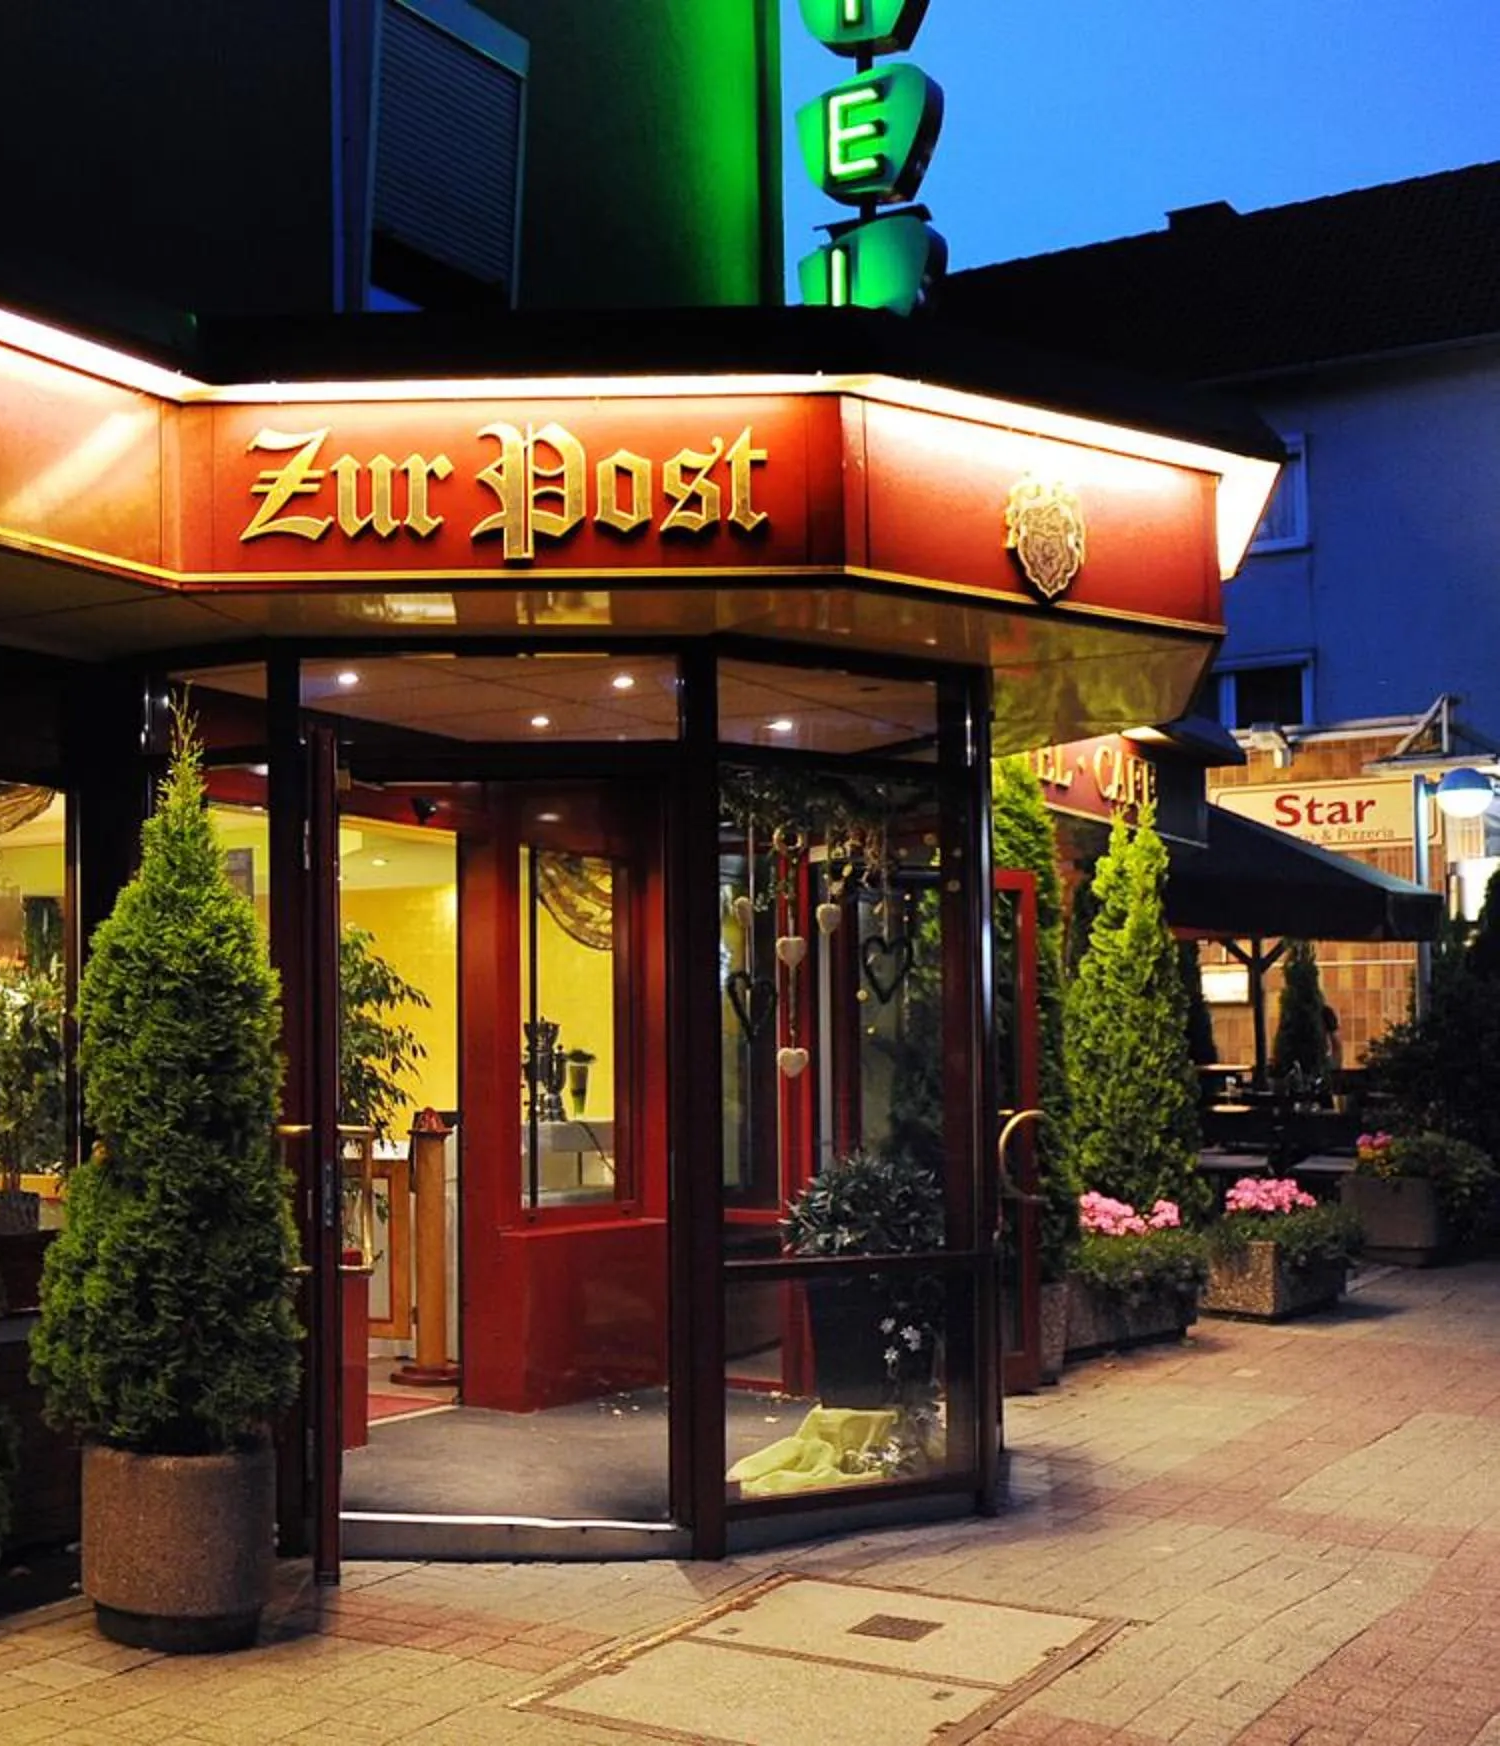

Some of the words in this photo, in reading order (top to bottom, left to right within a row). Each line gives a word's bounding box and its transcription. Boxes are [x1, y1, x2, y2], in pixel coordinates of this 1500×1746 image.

[239, 426, 454, 542] Zur
[470, 421, 768, 560] Post
[1028, 744, 1074, 788] EL
[1274, 794, 1376, 827] Star
[1337, 827, 1396, 841] Pizzeria
